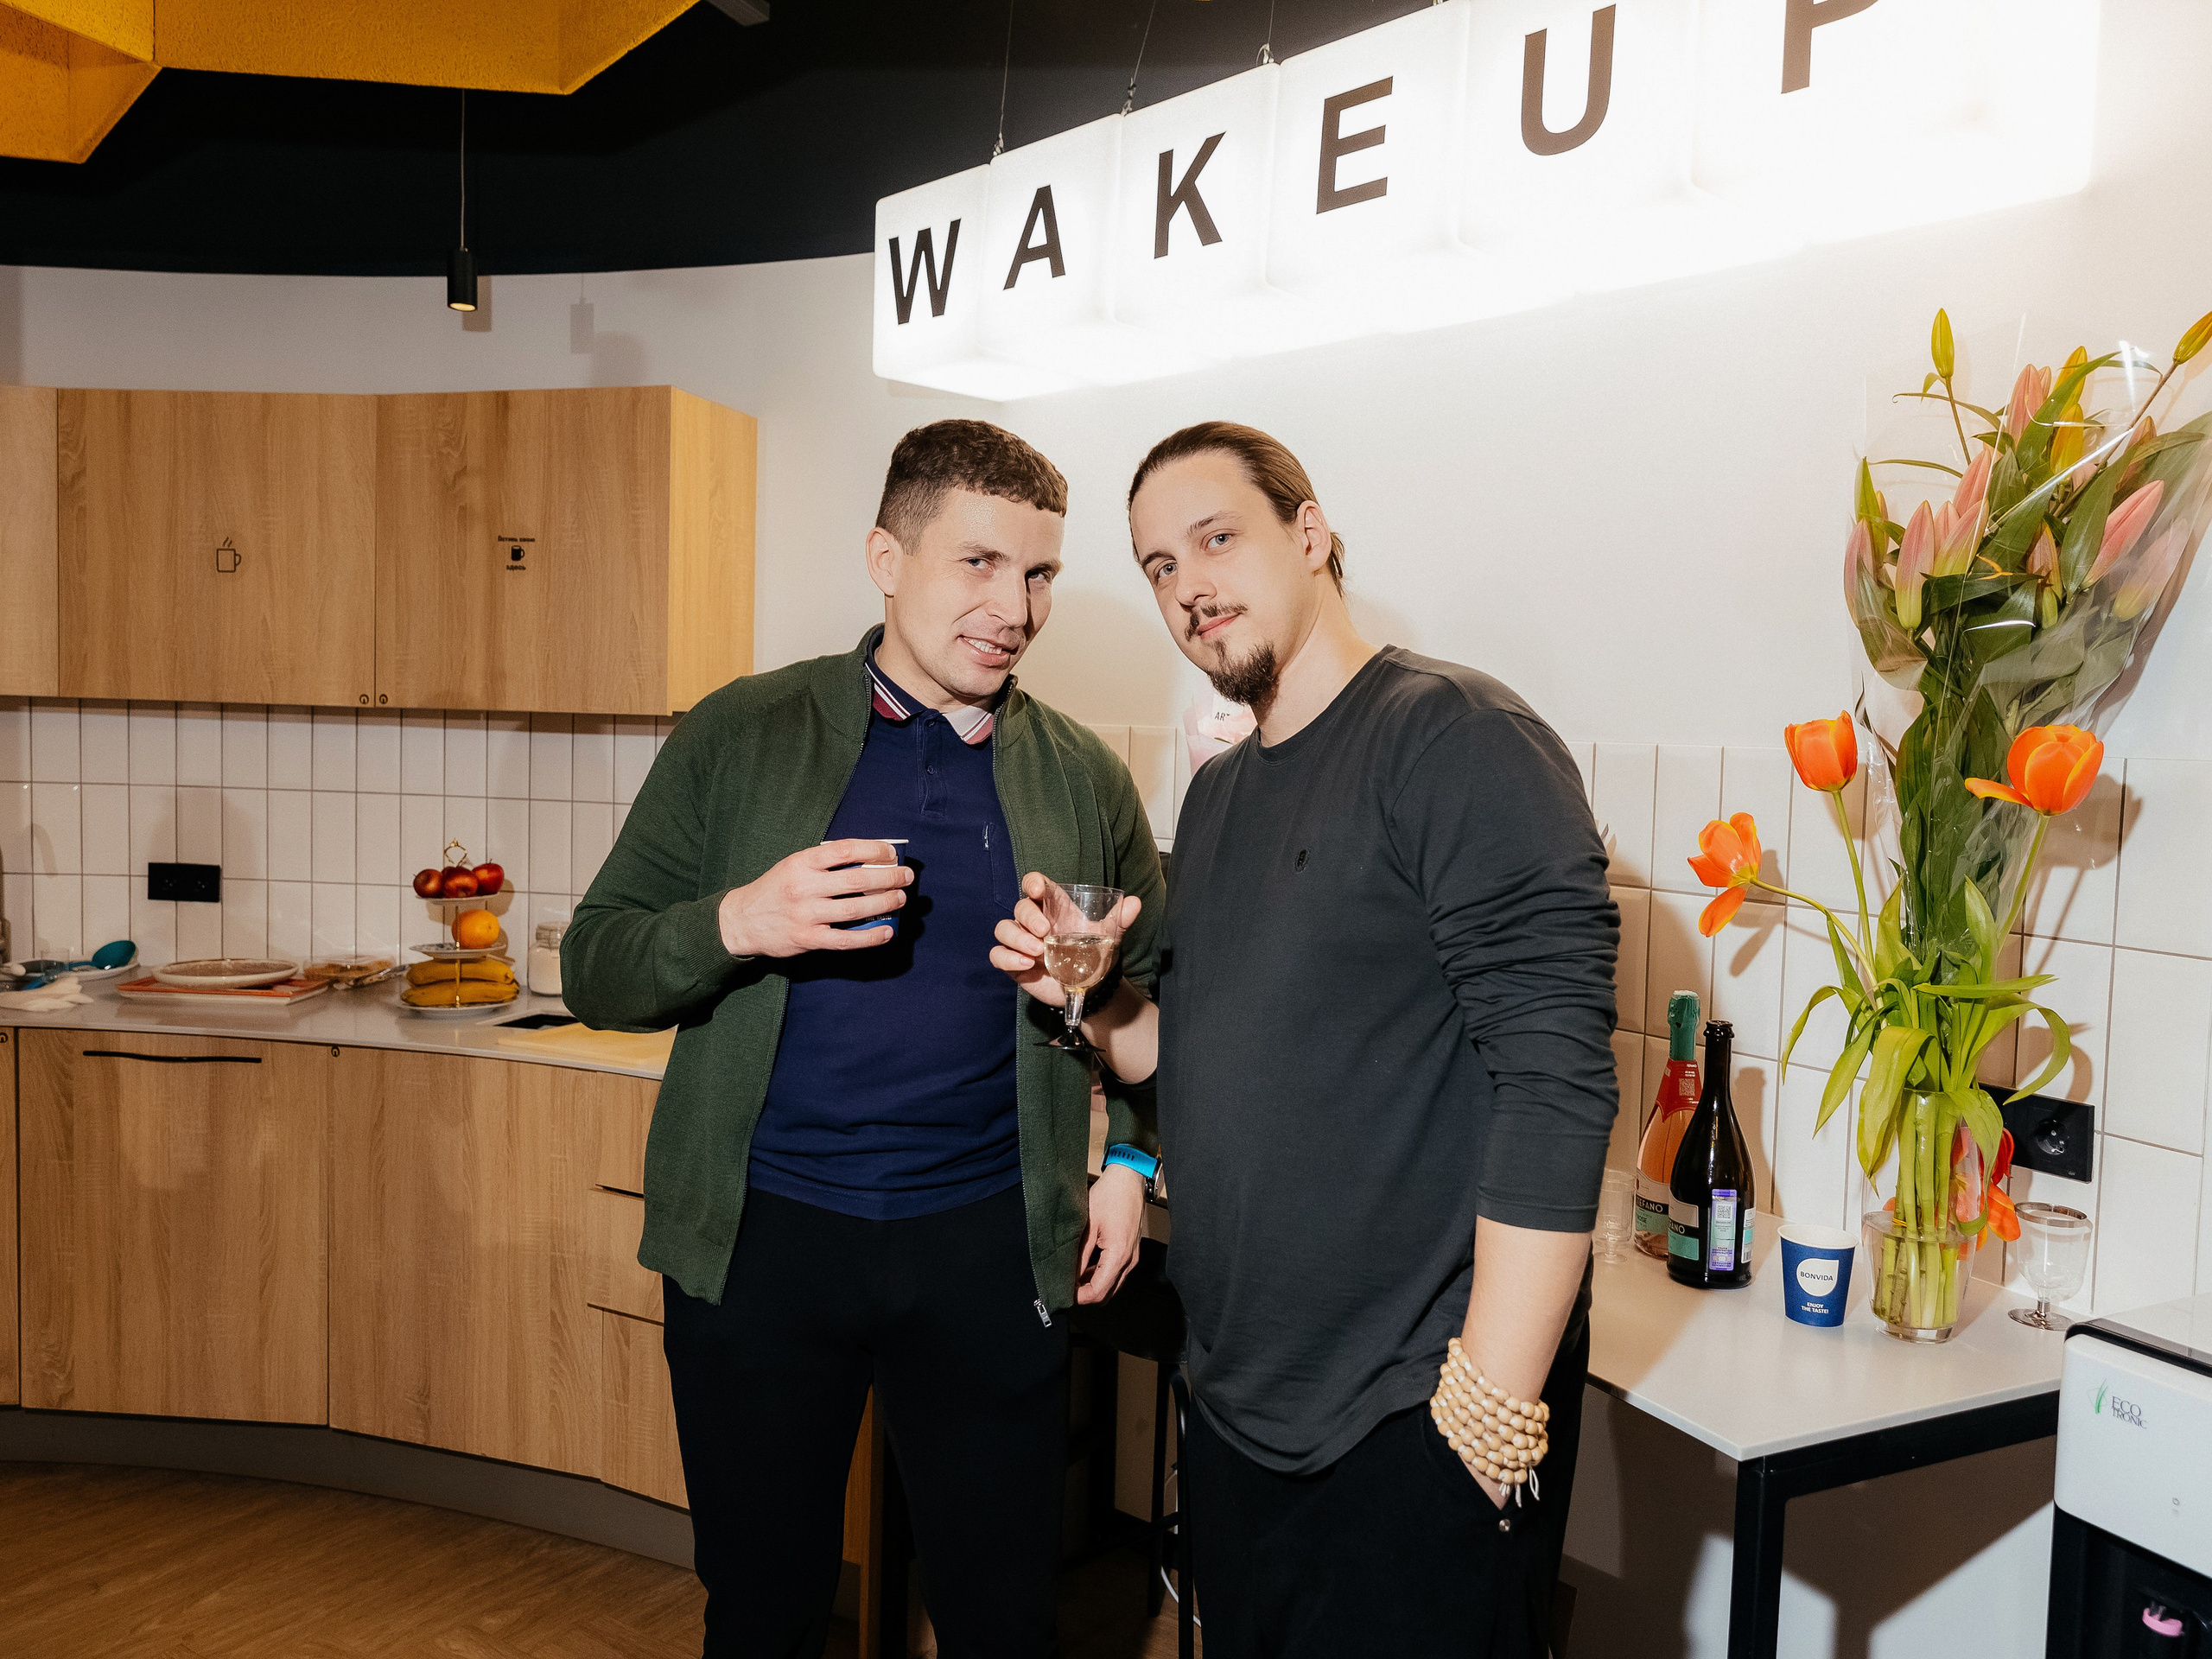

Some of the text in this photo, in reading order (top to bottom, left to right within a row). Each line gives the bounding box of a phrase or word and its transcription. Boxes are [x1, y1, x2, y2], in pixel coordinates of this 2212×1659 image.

[1800, 1271, 1834, 1281] BONVIDA
[2112, 1395, 2141, 1417] ECO
[2112, 1408, 2148, 1429] TRONIC
